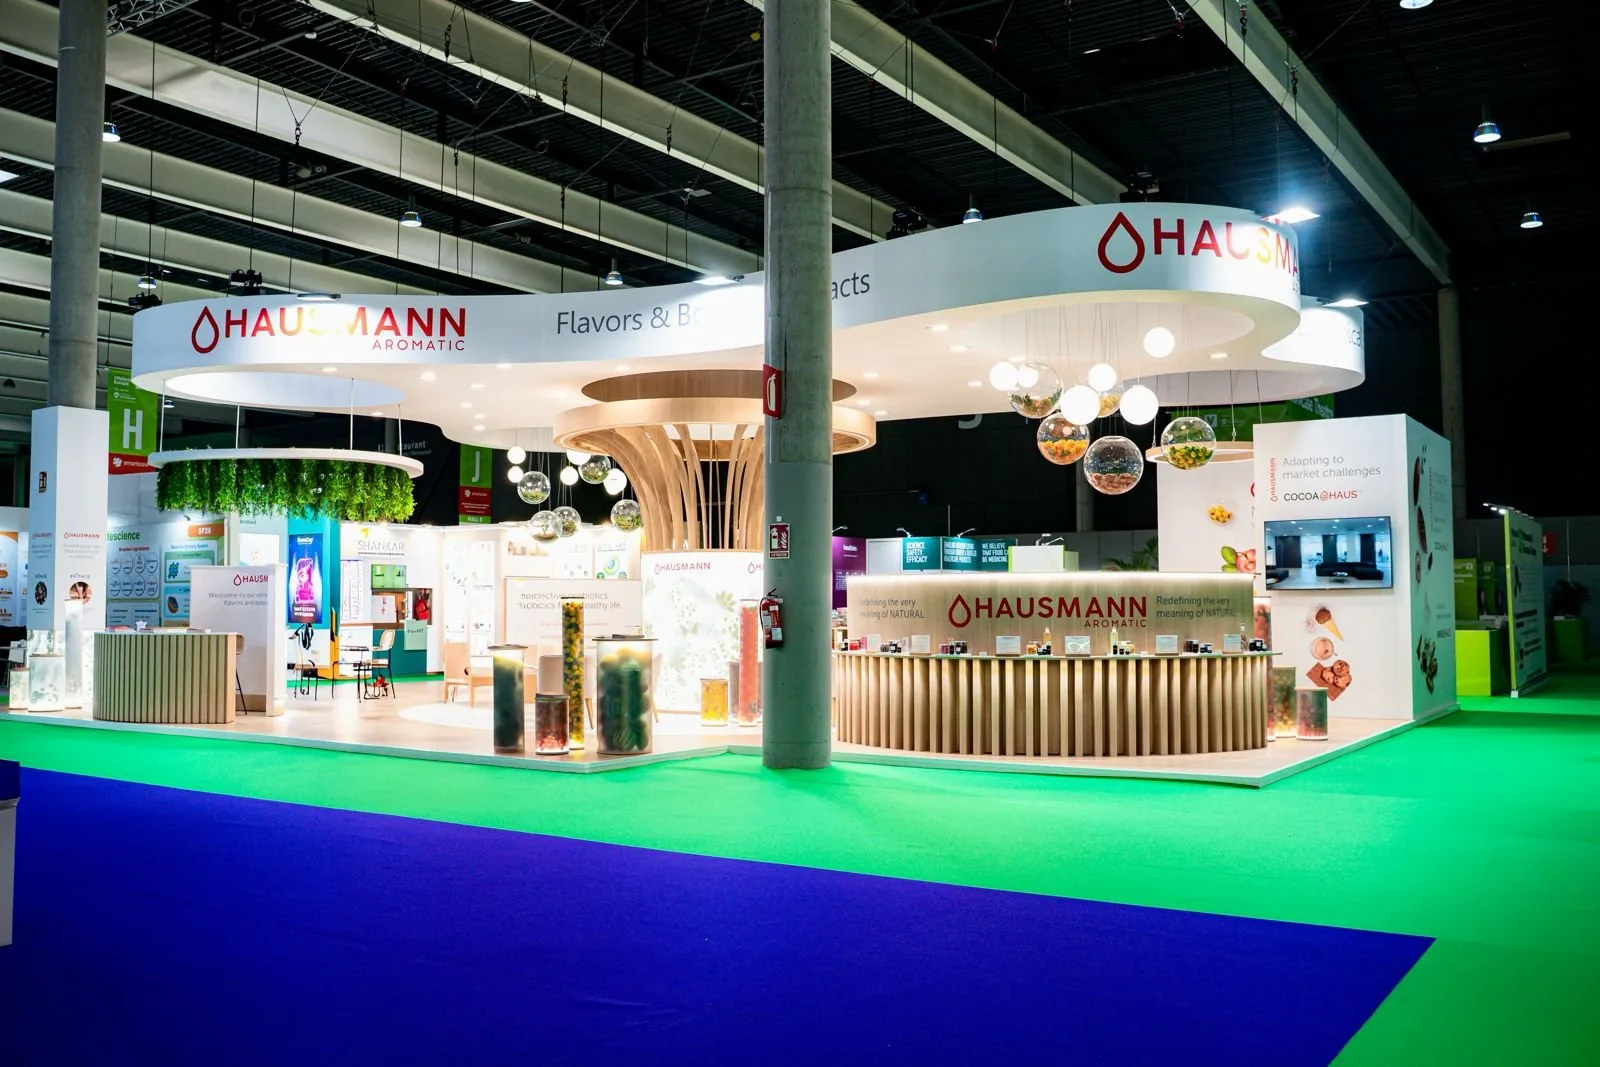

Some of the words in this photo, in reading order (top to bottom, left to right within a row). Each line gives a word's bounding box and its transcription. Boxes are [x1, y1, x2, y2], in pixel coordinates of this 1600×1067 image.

[557, 310, 642, 334] Flavors
[650, 307, 671, 329] &
[372, 339, 465, 351] AROMATIC
[123, 408, 143, 450] H
[472, 451, 481, 483] J
[1283, 456, 1329, 468] Adapting
[1333, 456, 1344, 464] to
[1283, 469, 1320, 480] market
[1323, 466, 1381, 478] challenges
[358, 540, 406, 552] SHANKAR
[906, 542, 925, 550] SCIENCE
[660, 562, 711, 572] HAUSMANN
[888, 599, 899, 607] the
[900, 600, 916, 609] very
[976, 595, 1147, 619] HAUSMANN
[1156, 595, 1201, 607] Redefining
[1203, 596, 1215, 605] the
[1216, 597, 1230, 607] very
[890, 609, 925, 619] NATURAL
[1156, 610, 1194, 620] meaning
[1196, 609, 1204, 618] of
[1084, 619, 1147, 629] AROMATIC
